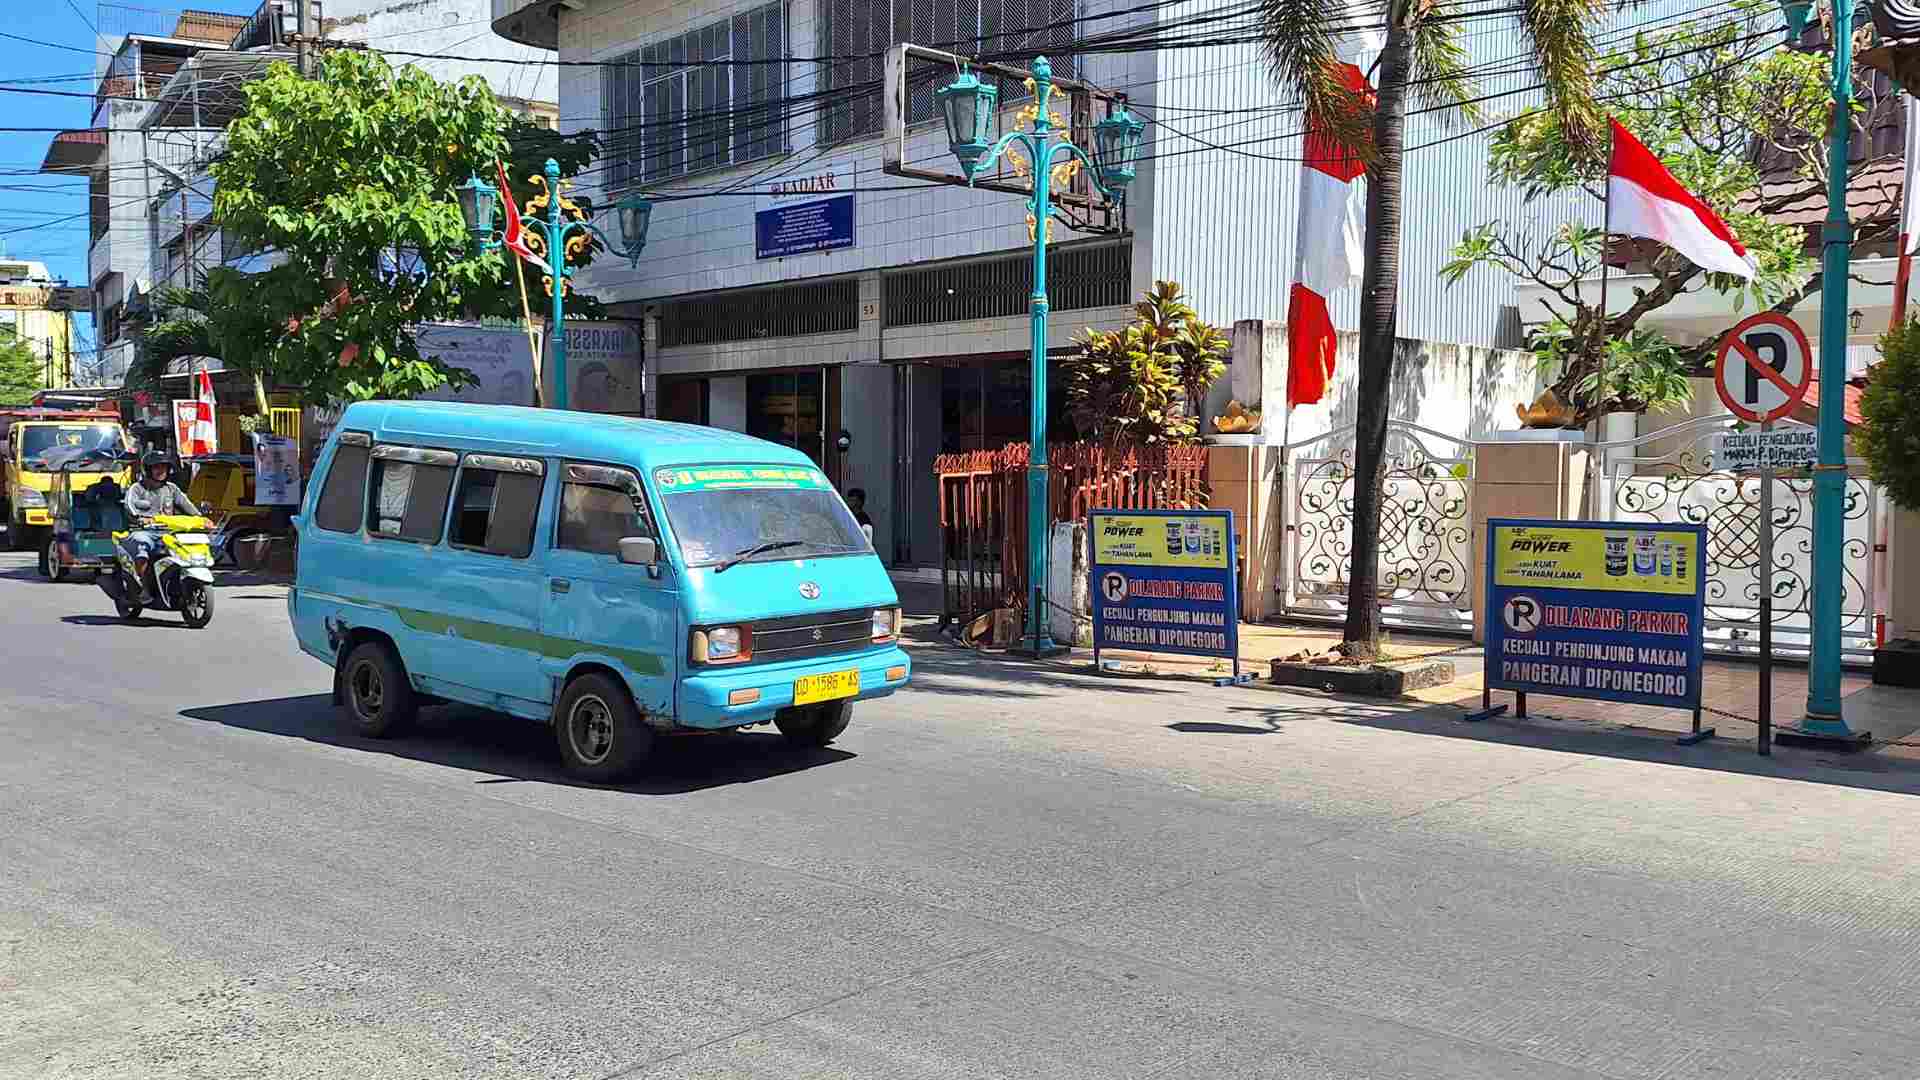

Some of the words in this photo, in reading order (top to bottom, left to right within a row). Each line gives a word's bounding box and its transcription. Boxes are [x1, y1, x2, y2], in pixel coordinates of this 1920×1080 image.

[1510, 539, 1571, 554] POWER
[1520, 568, 1554, 580] TAHAN
[1554, 570, 1583, 581] LAMA
[1128, 578, 1182, 598] DILARANG
[1103, 607, 1135, 620] KECUALI
[1137, 608, 1190, 625] PENGUNJUNG
[1192, 611, 1225, 626] MAKAM
[1544, 604, 1624, 630] DILARANG
[1627, 609, 1689, 637] PARKIR
[1104, 624, 1157, 645] PANGERAN
[1159, 628, 1226, 650] DIPONEGORO
[1503, 638, 1550, 656] KECUALI
[1555, 641, 1635, 663] PENGUNJUNG
[1639, 647, 1688, 667] MAKAM
[1503, 661, 1580, 687] PANGERAN
[1585, 667, 1687, 697] DIPONEGORO
